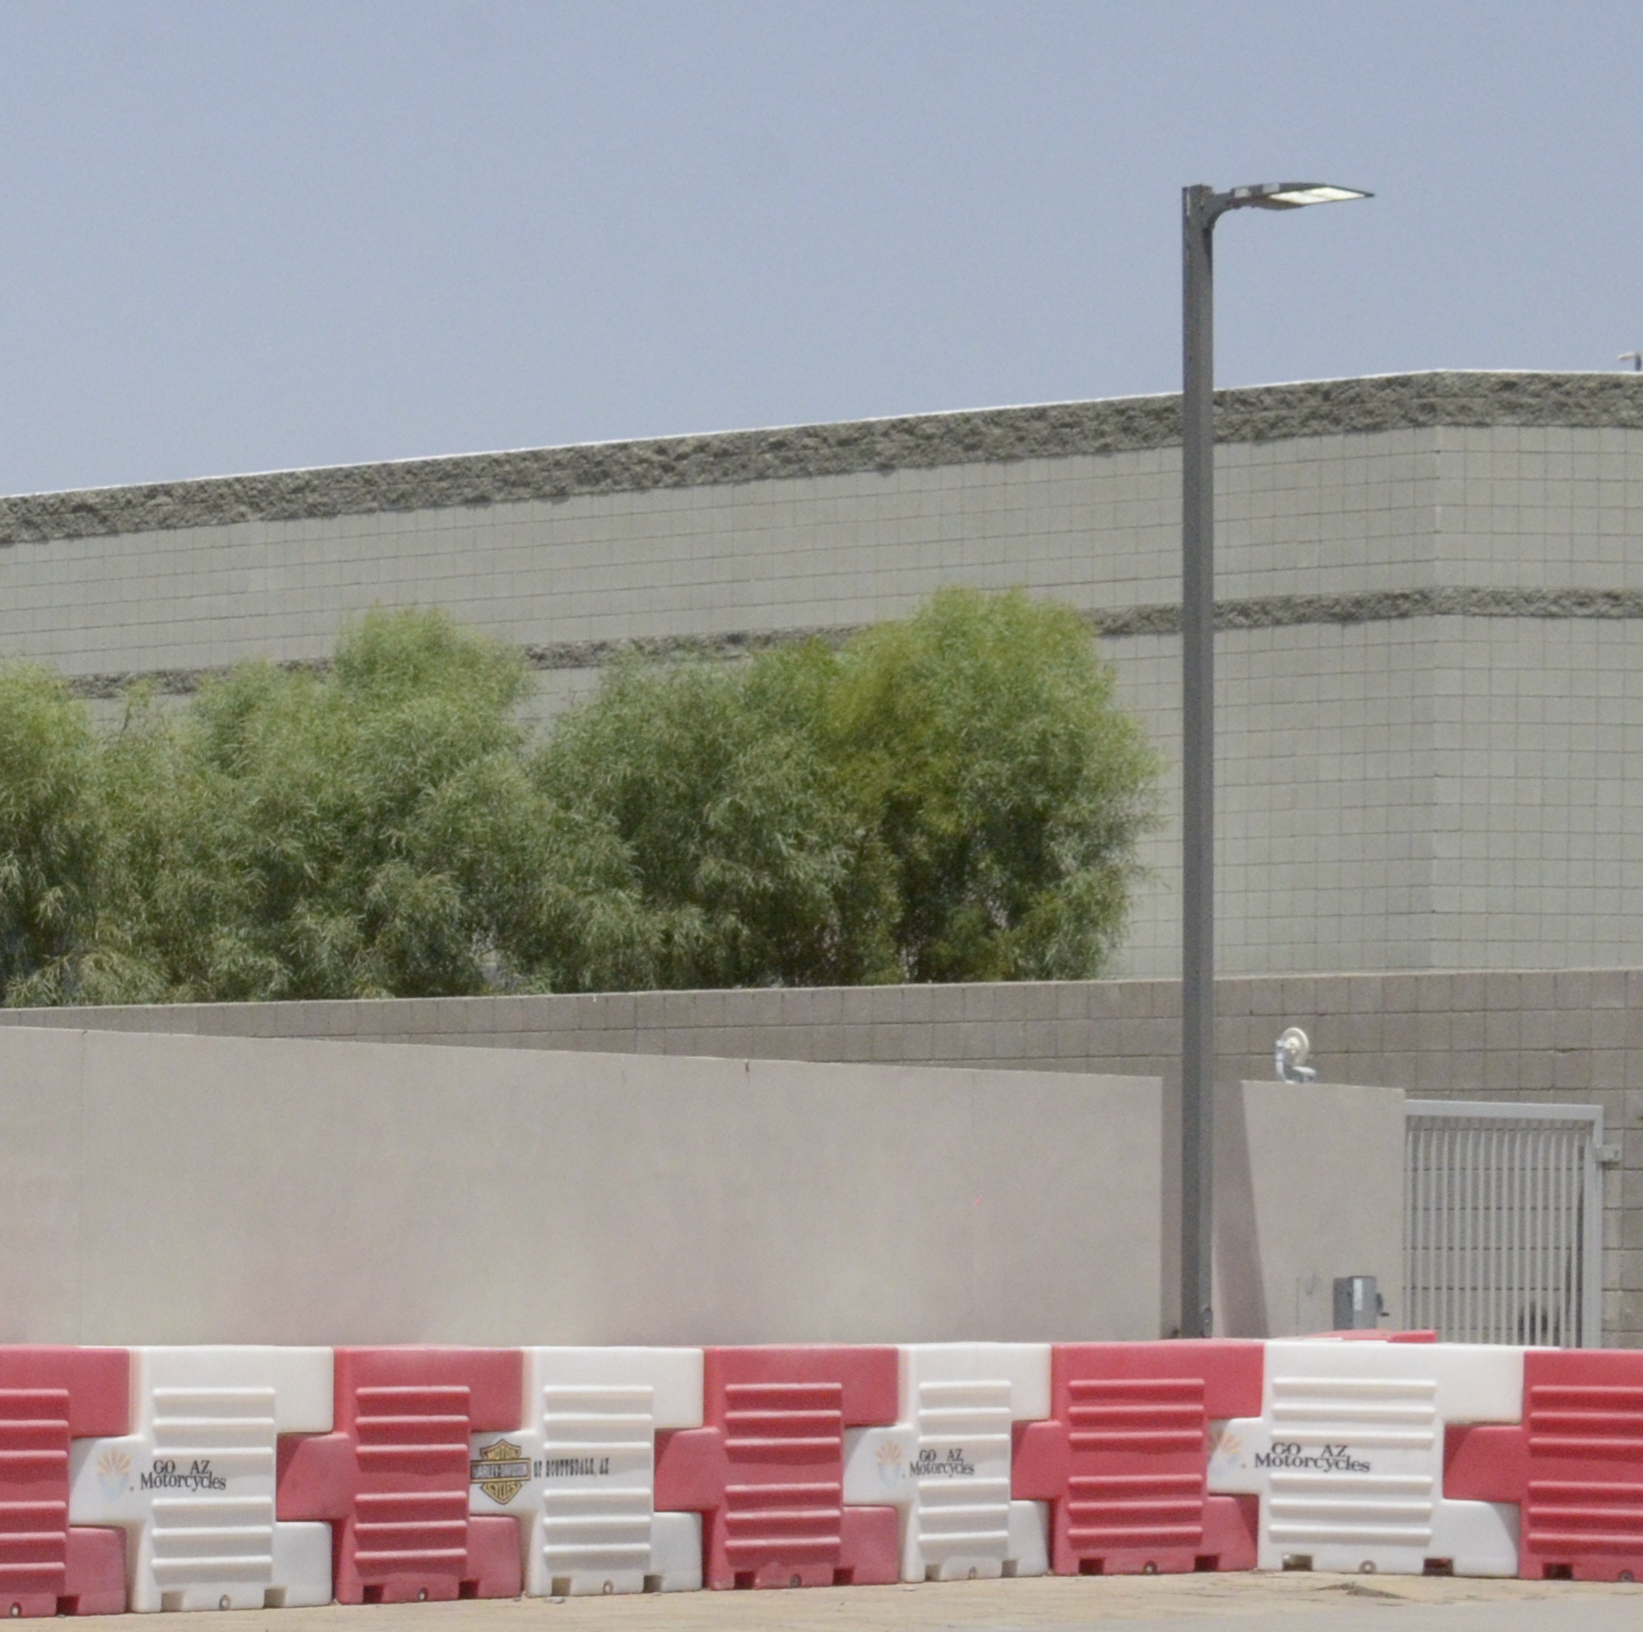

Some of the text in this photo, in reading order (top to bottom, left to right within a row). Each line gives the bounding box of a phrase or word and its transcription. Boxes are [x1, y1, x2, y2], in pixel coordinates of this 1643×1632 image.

[1271, 1442, 1349, 1457] GO AZ
[153, 1460, 210, 1474] GO AZ
[1254, 1452, 1370, 1473] Motorcycles
[140, 1471, 226, 1492] Motorcycles
